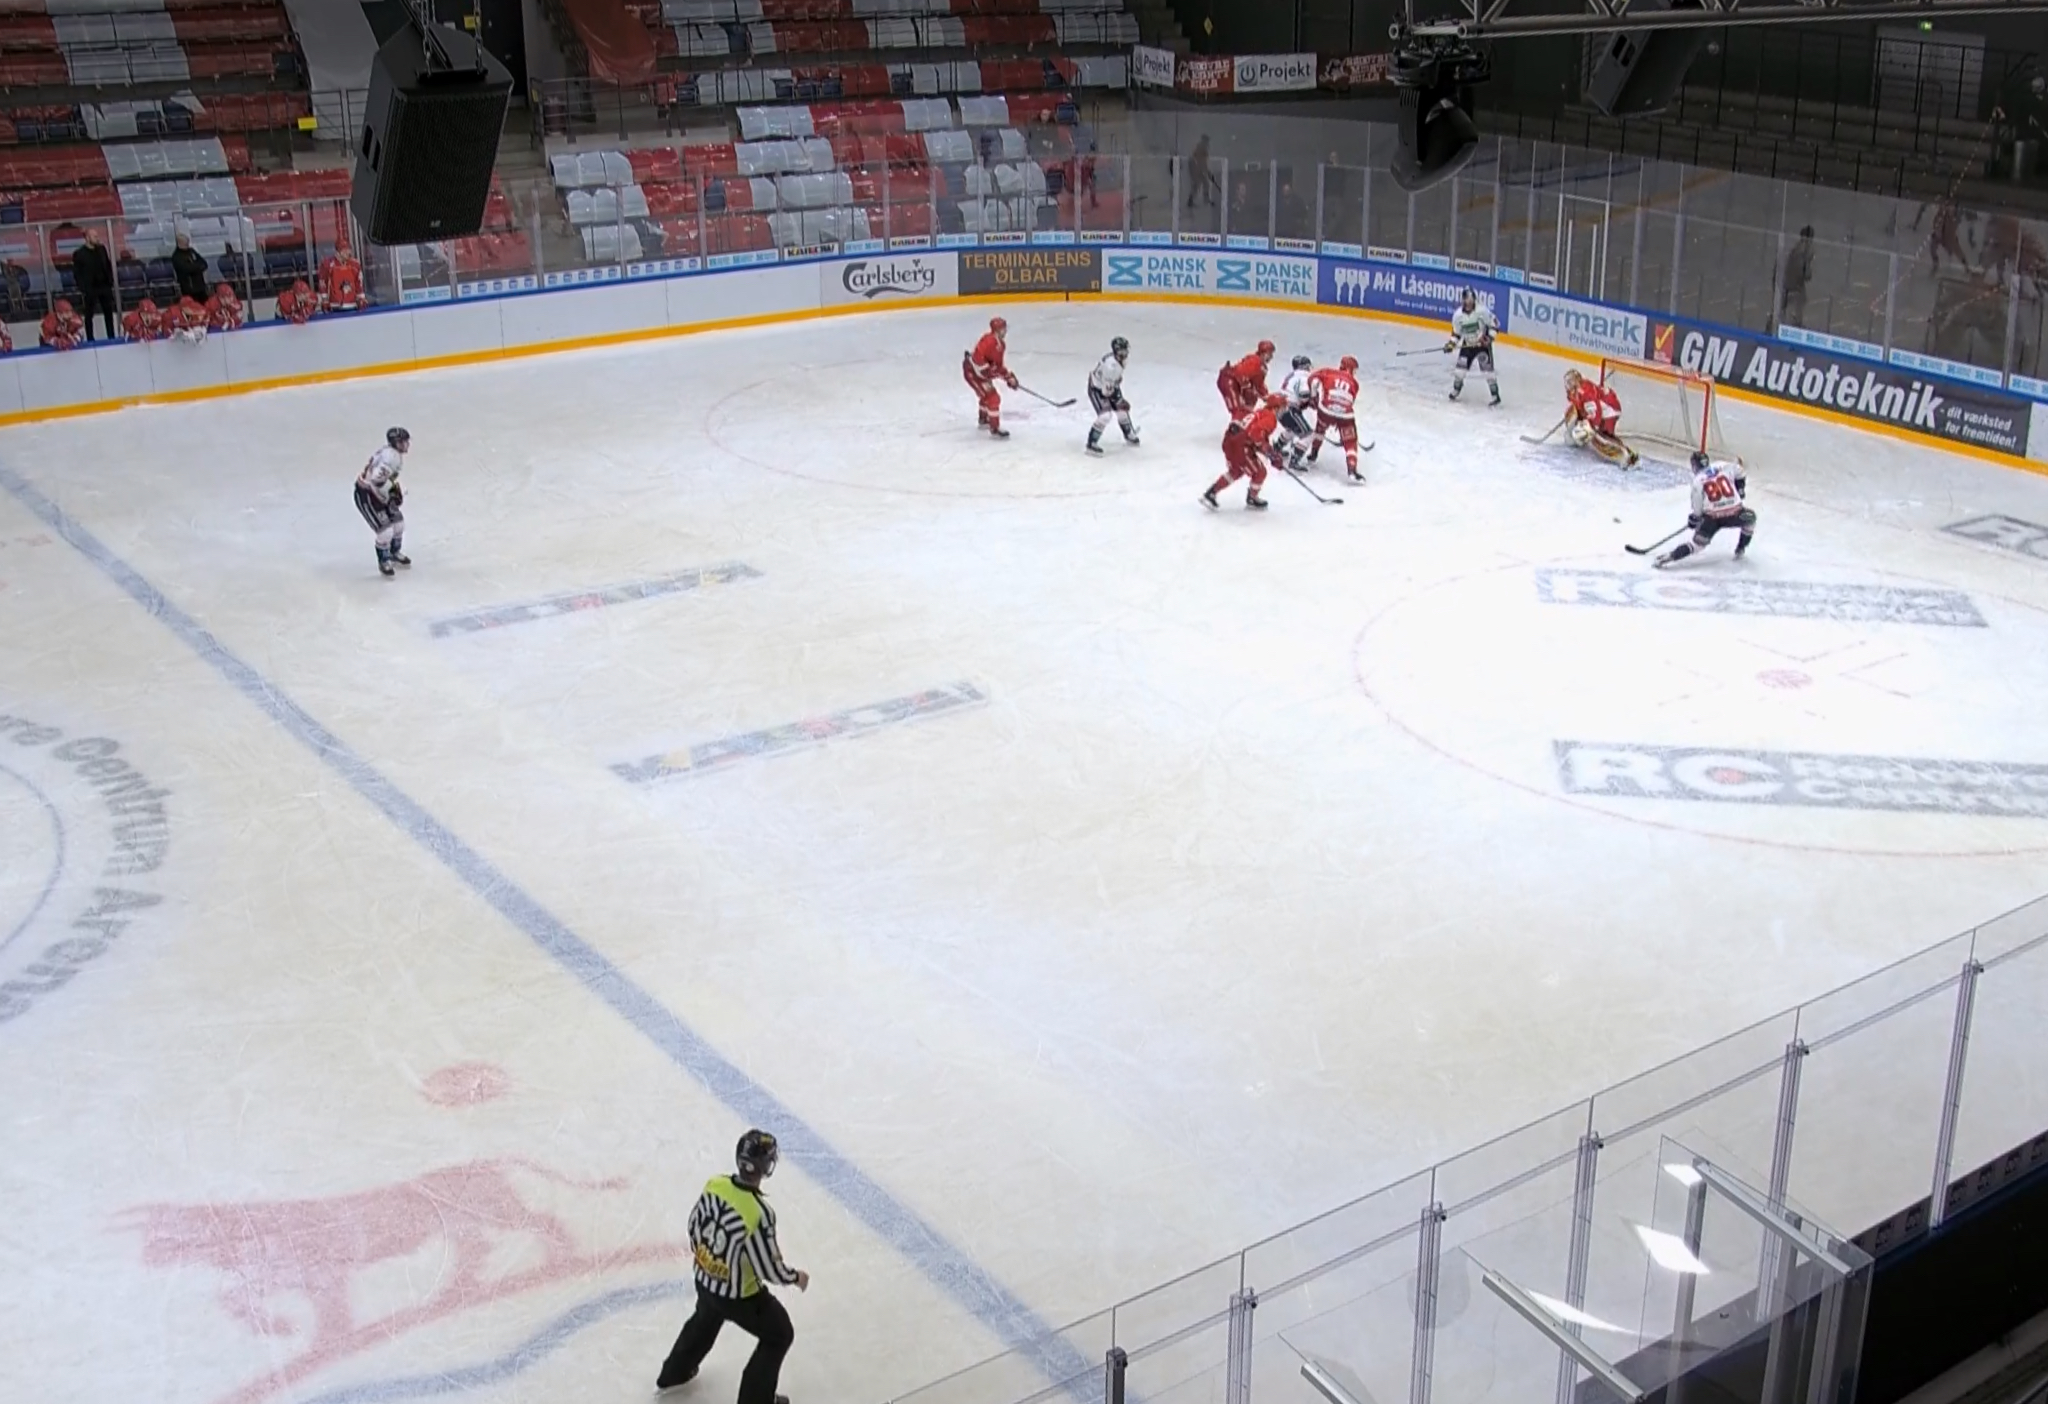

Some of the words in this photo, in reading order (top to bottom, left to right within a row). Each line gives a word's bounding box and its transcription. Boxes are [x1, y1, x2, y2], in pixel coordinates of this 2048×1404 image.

[1143, 54, 1171, 77] Projekt
[1259, 61, 1311, 83] Projekt
[963, 250, 1092, 269] TERMINALENS
[1147, 256, 1207, 273] DANSK
[842, 260, 936, 296] Carlsberg
[995, 267, 1058, 285] ØLBAR
[1147, 273, 1205, 289] METAL
[1255, 261, 1313, 281] DANSK
[1255, 278, 1311, 297] METAL
[1513, 293, 1641, 344] Nørmark
[1569, 332, 1640, 358] Privathospital
[1333, 377, 1351, 392] 10
[1680, 331, 1738, 380] GM
[1743, 346, 1944, 429] Autoteknik
[1946, 406, 1962, 421] dit
[1963, 411, 2012, 432] værksted
[1945, 420, 1960, 435] for
[1961, 423, 2017, 449] fremtiden!
[1703, 474, 1735, 503] 80
